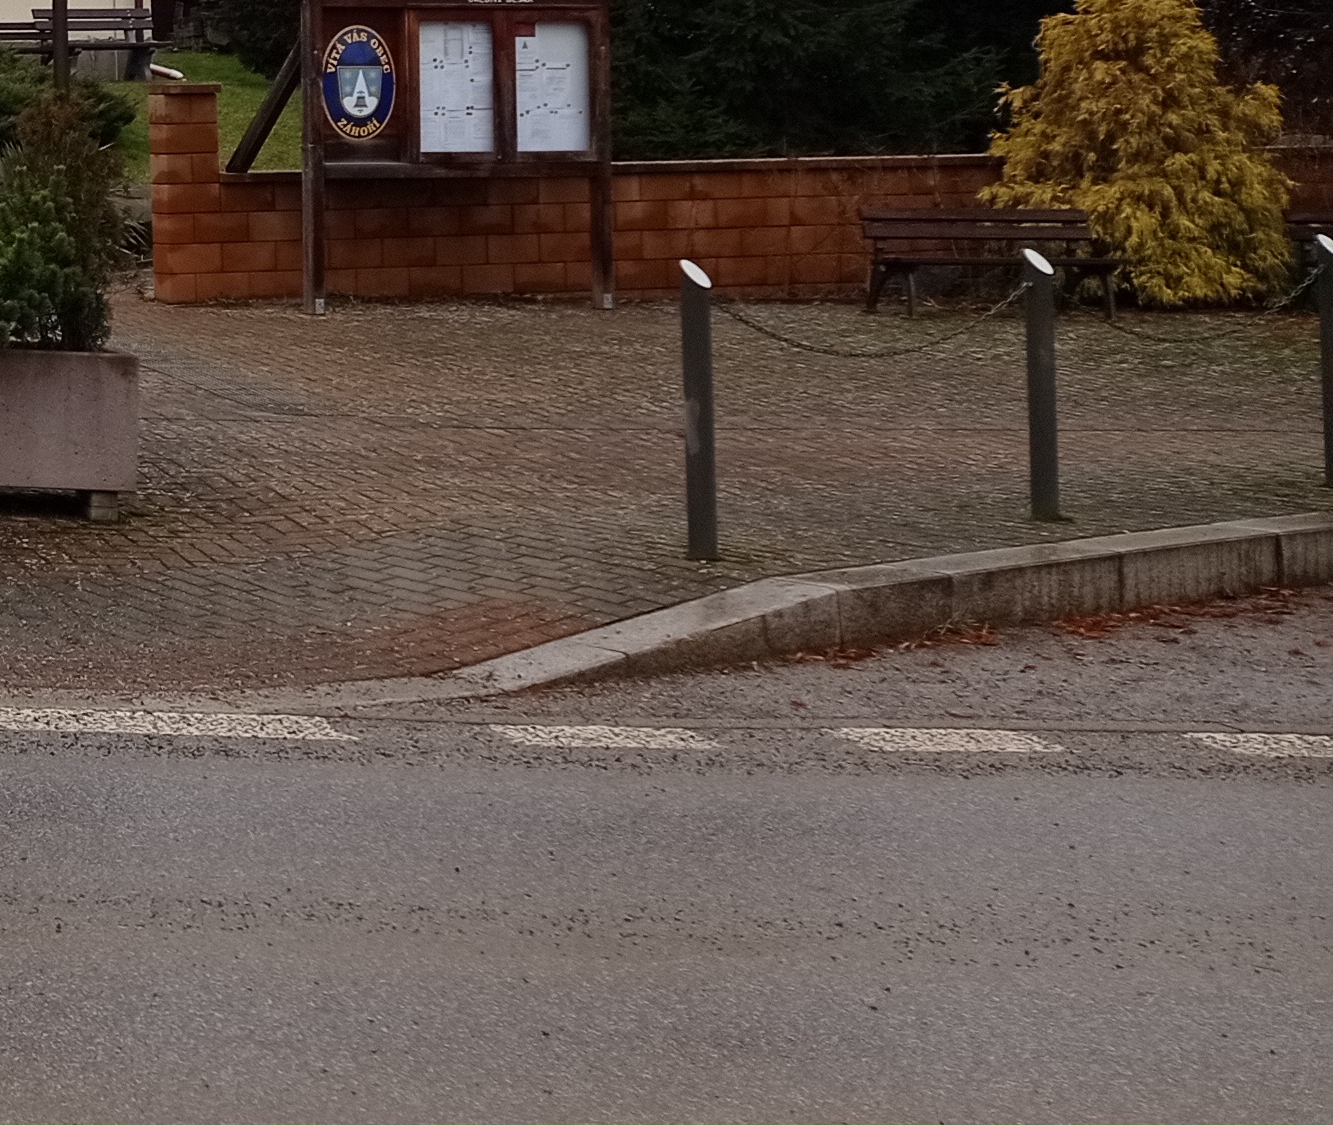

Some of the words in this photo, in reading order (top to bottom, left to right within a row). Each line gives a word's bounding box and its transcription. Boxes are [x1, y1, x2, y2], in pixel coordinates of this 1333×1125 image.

[326, 41, 346, 73] VÍTÁ
[343, 29, 369, 44] VÁS
[370, 39, 391, 73] OBEC
[336, 117, 381, 137] ZÁHOŘÍ
